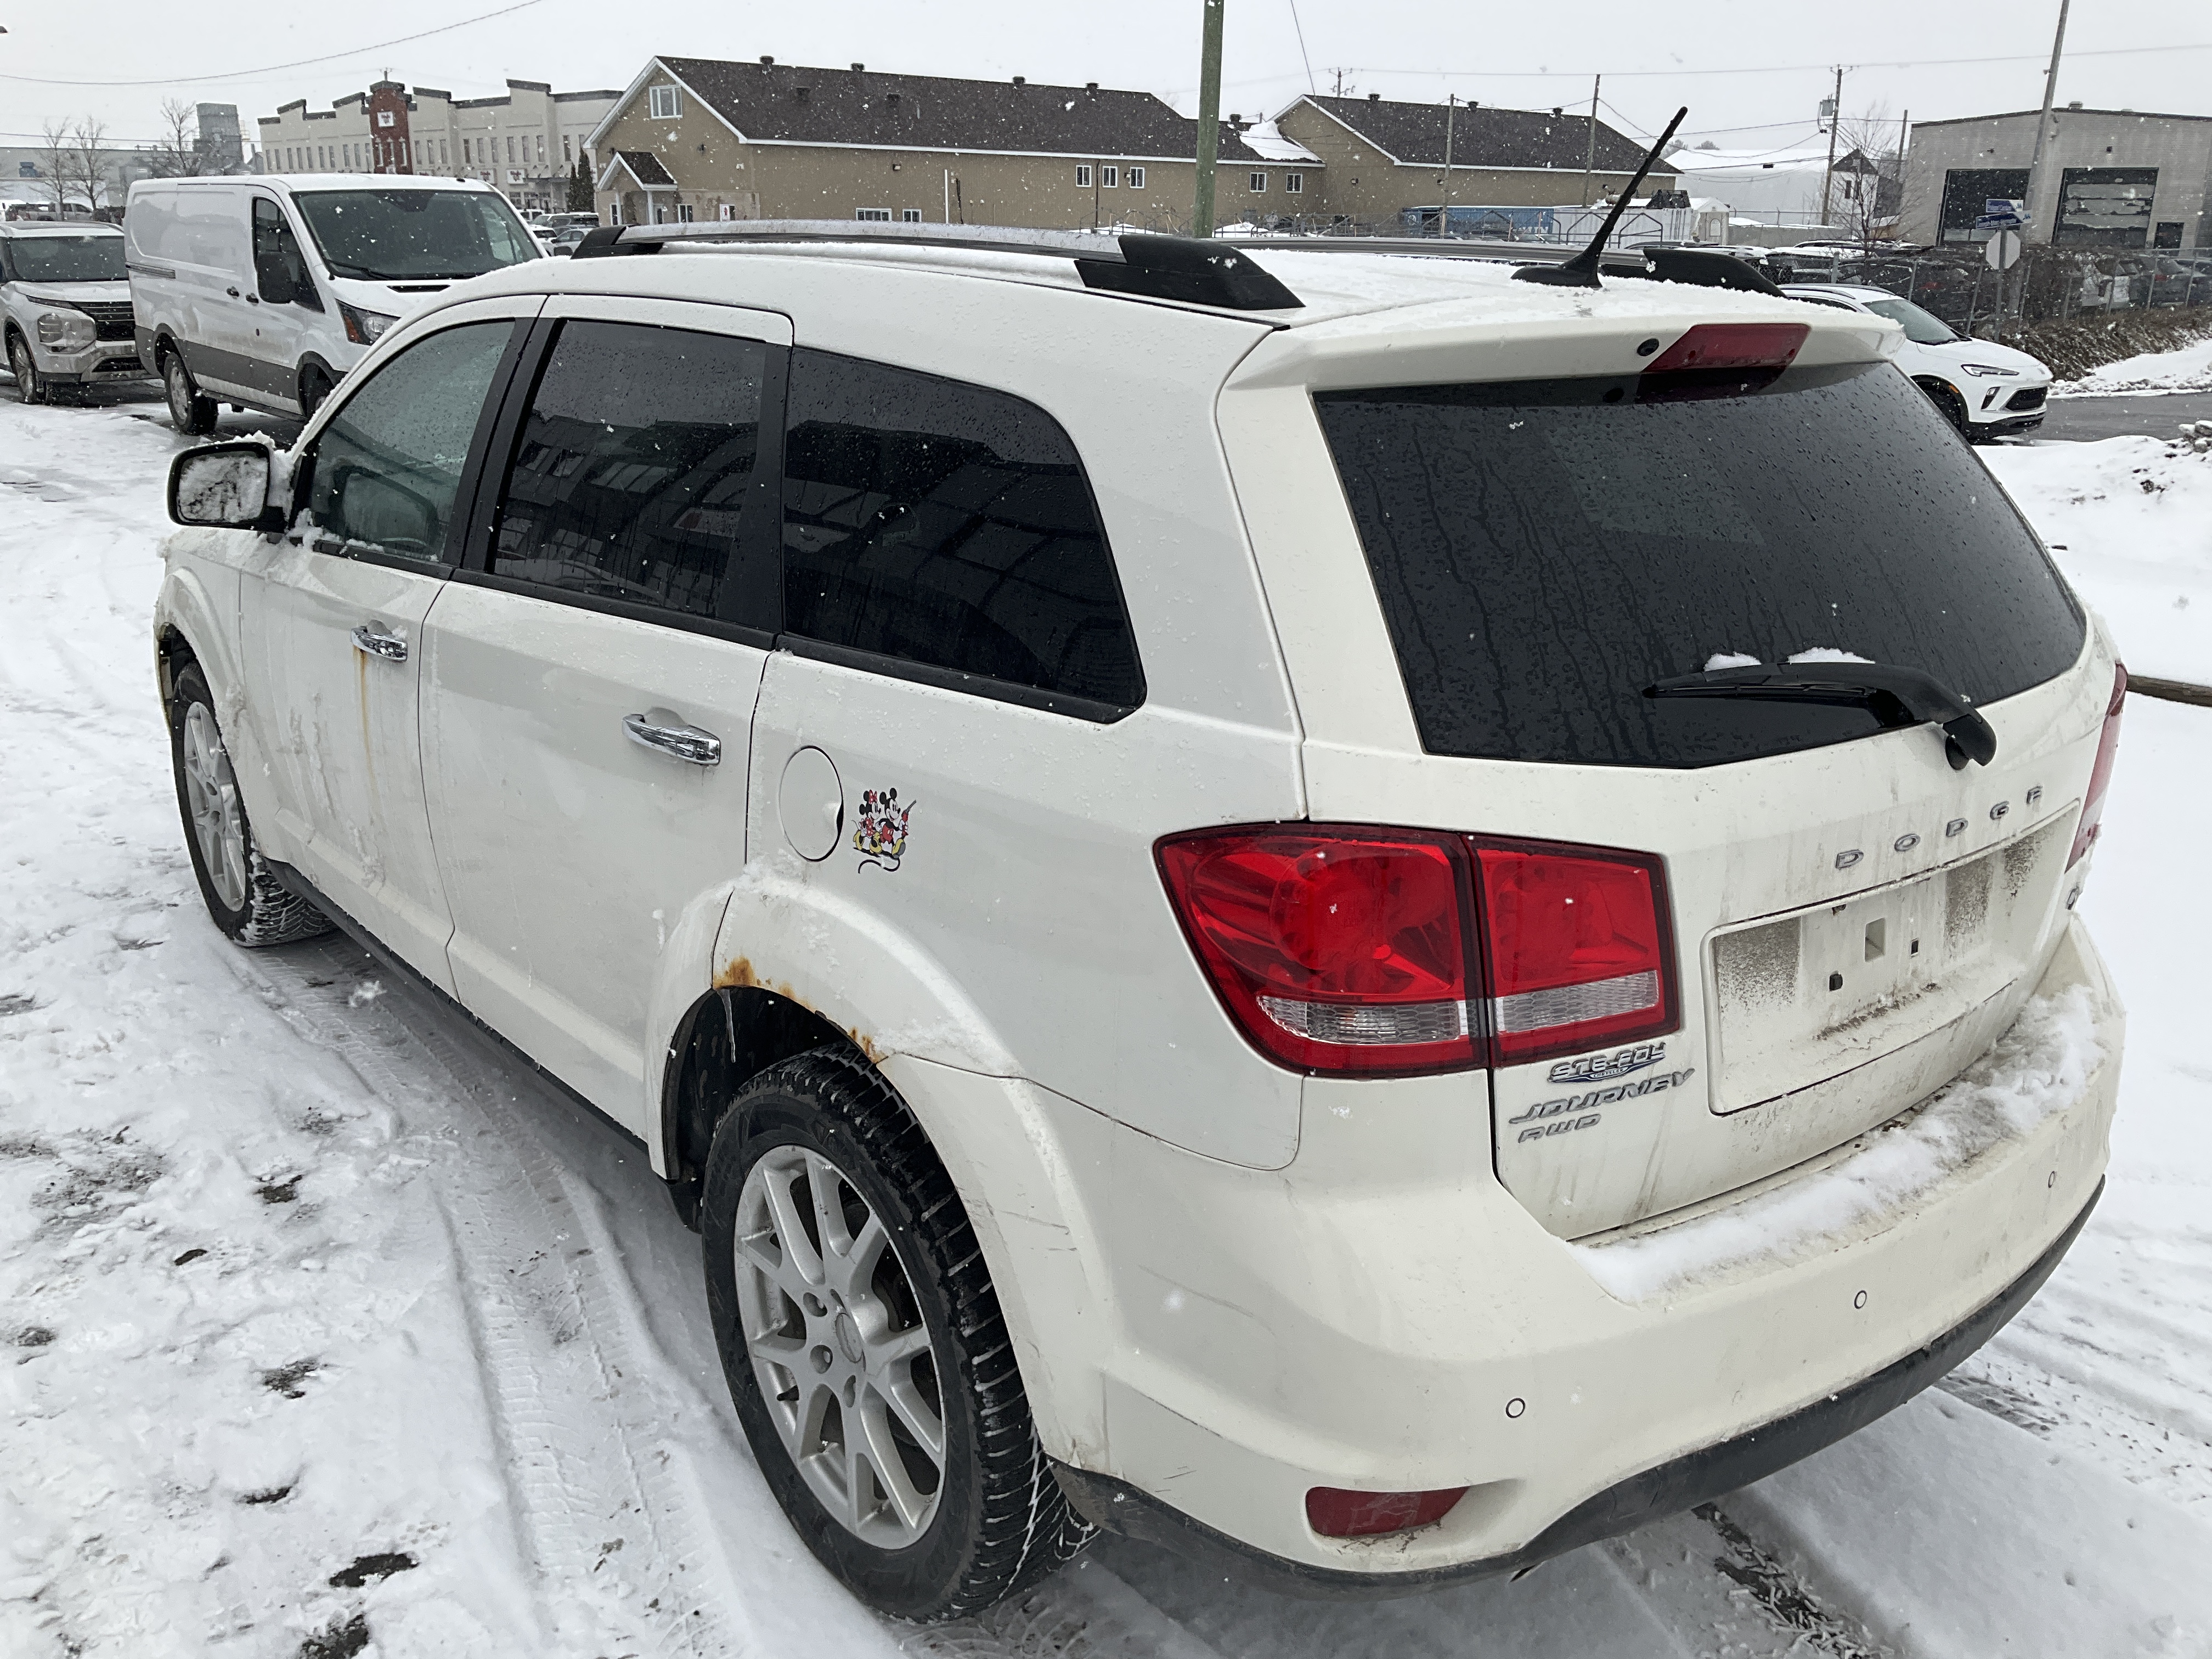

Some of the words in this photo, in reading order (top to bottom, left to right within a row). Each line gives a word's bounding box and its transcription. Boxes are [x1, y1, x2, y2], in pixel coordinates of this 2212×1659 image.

[1836, 786, 2043, 869] DODGE
[1593, 1068, 1624, 1078] CHRYSLER
[1509, 1068, 1696, 1125] JOURNEY
[1517, 1113, 1602, 1143] AWD
